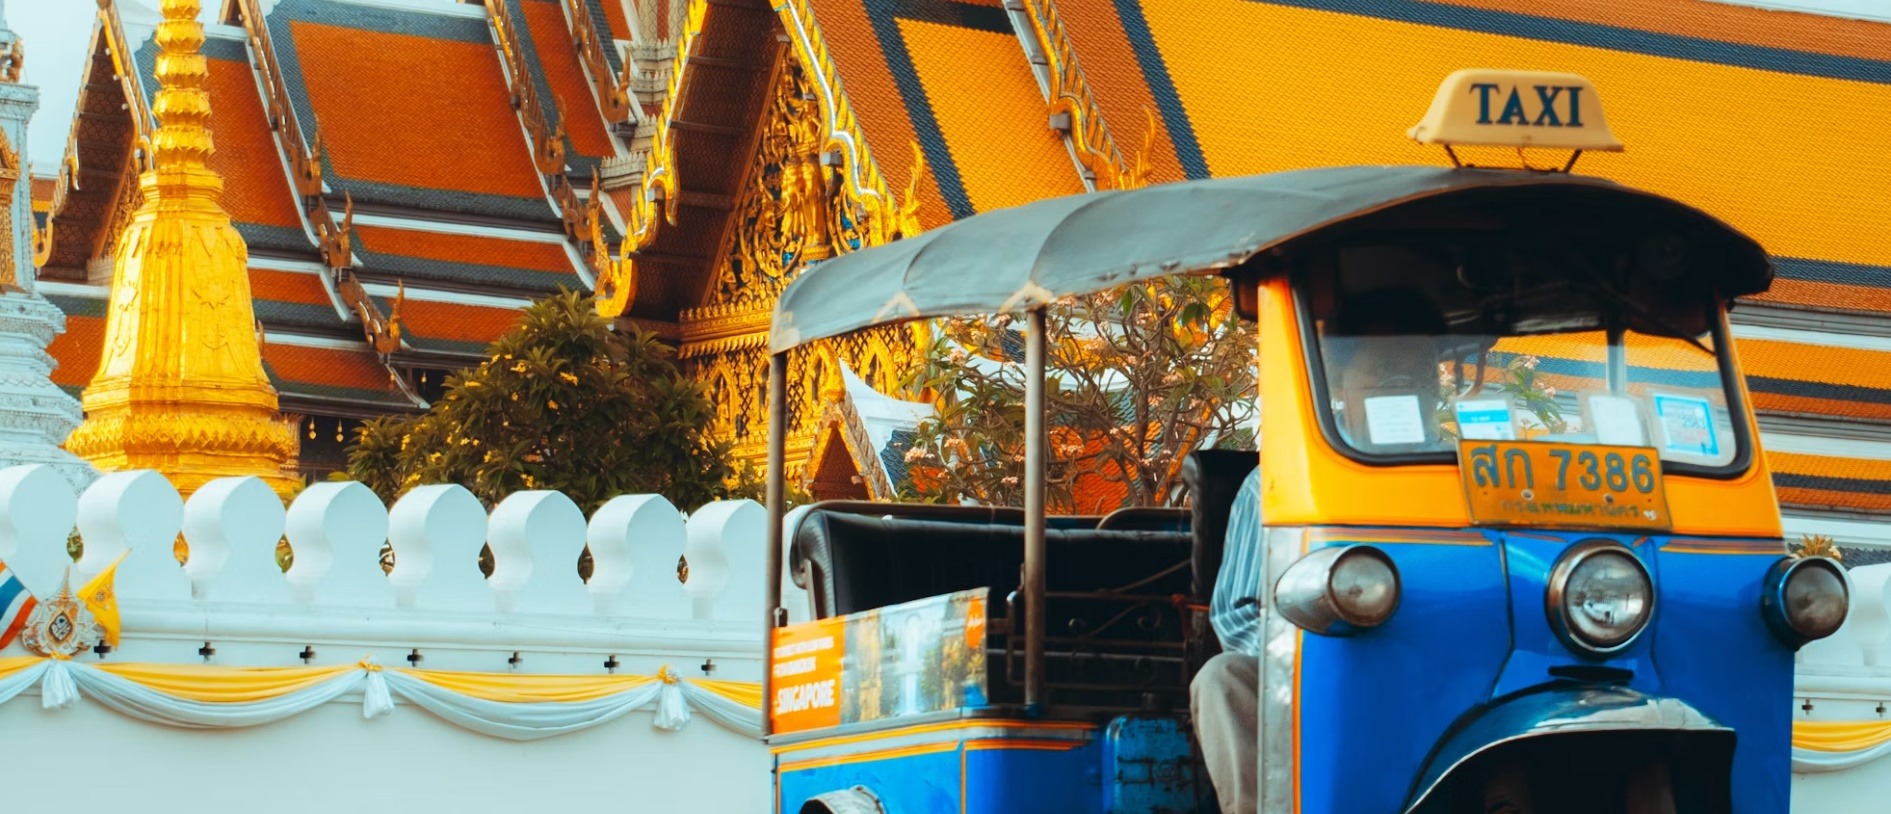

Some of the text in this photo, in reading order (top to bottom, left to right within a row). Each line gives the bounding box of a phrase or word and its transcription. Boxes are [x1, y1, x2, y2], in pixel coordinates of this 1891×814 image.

[1469, 83, 1584, 127] TAXI
[1470, 443, 1655, 494] สก 7386
